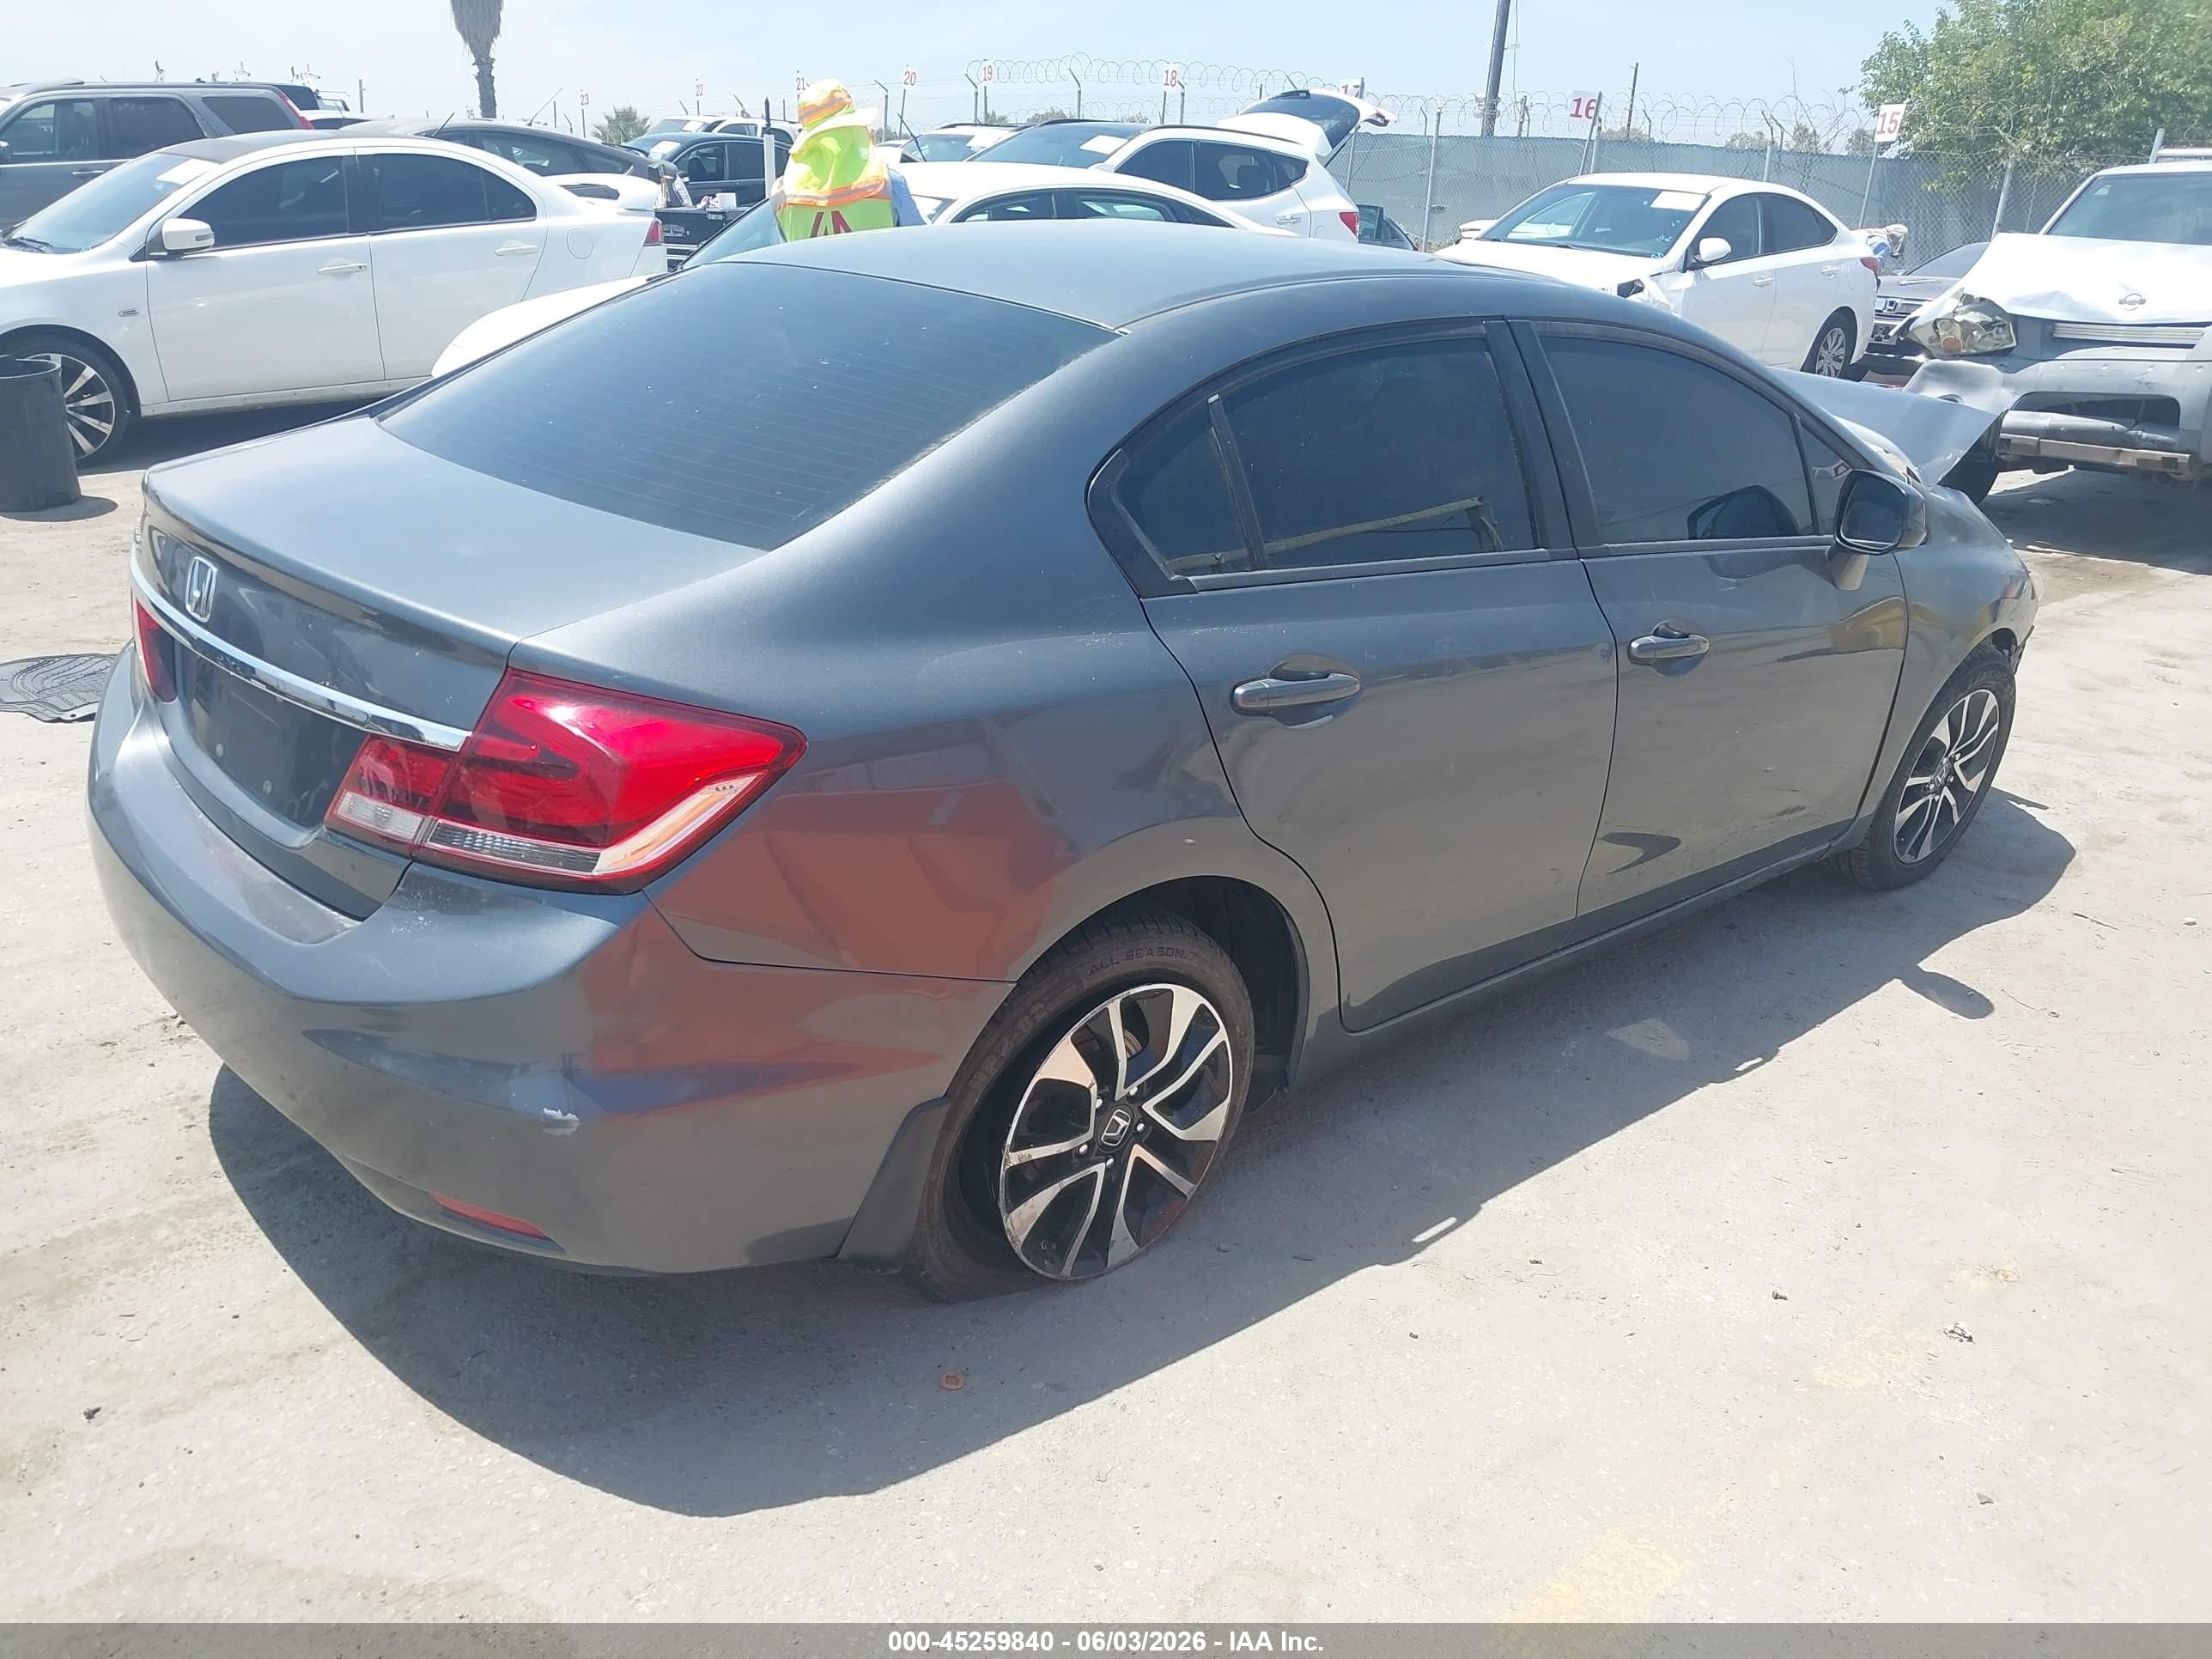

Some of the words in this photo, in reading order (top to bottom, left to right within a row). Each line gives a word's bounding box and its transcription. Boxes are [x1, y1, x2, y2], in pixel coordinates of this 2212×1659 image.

[903, 70, 917, 87] 20
[982, 65, 992, 82] 19
[1163, 70, 1177, 88] 18
[696, 84, 703, 97] 22
[796, 77, 805, 91] 21
[580, 94, 589, 106] 23
[1570, 96, 1596, 119] 16
[1876, 112, 1899, 135] 15
[1089, 957, 1120, 975] ALL
